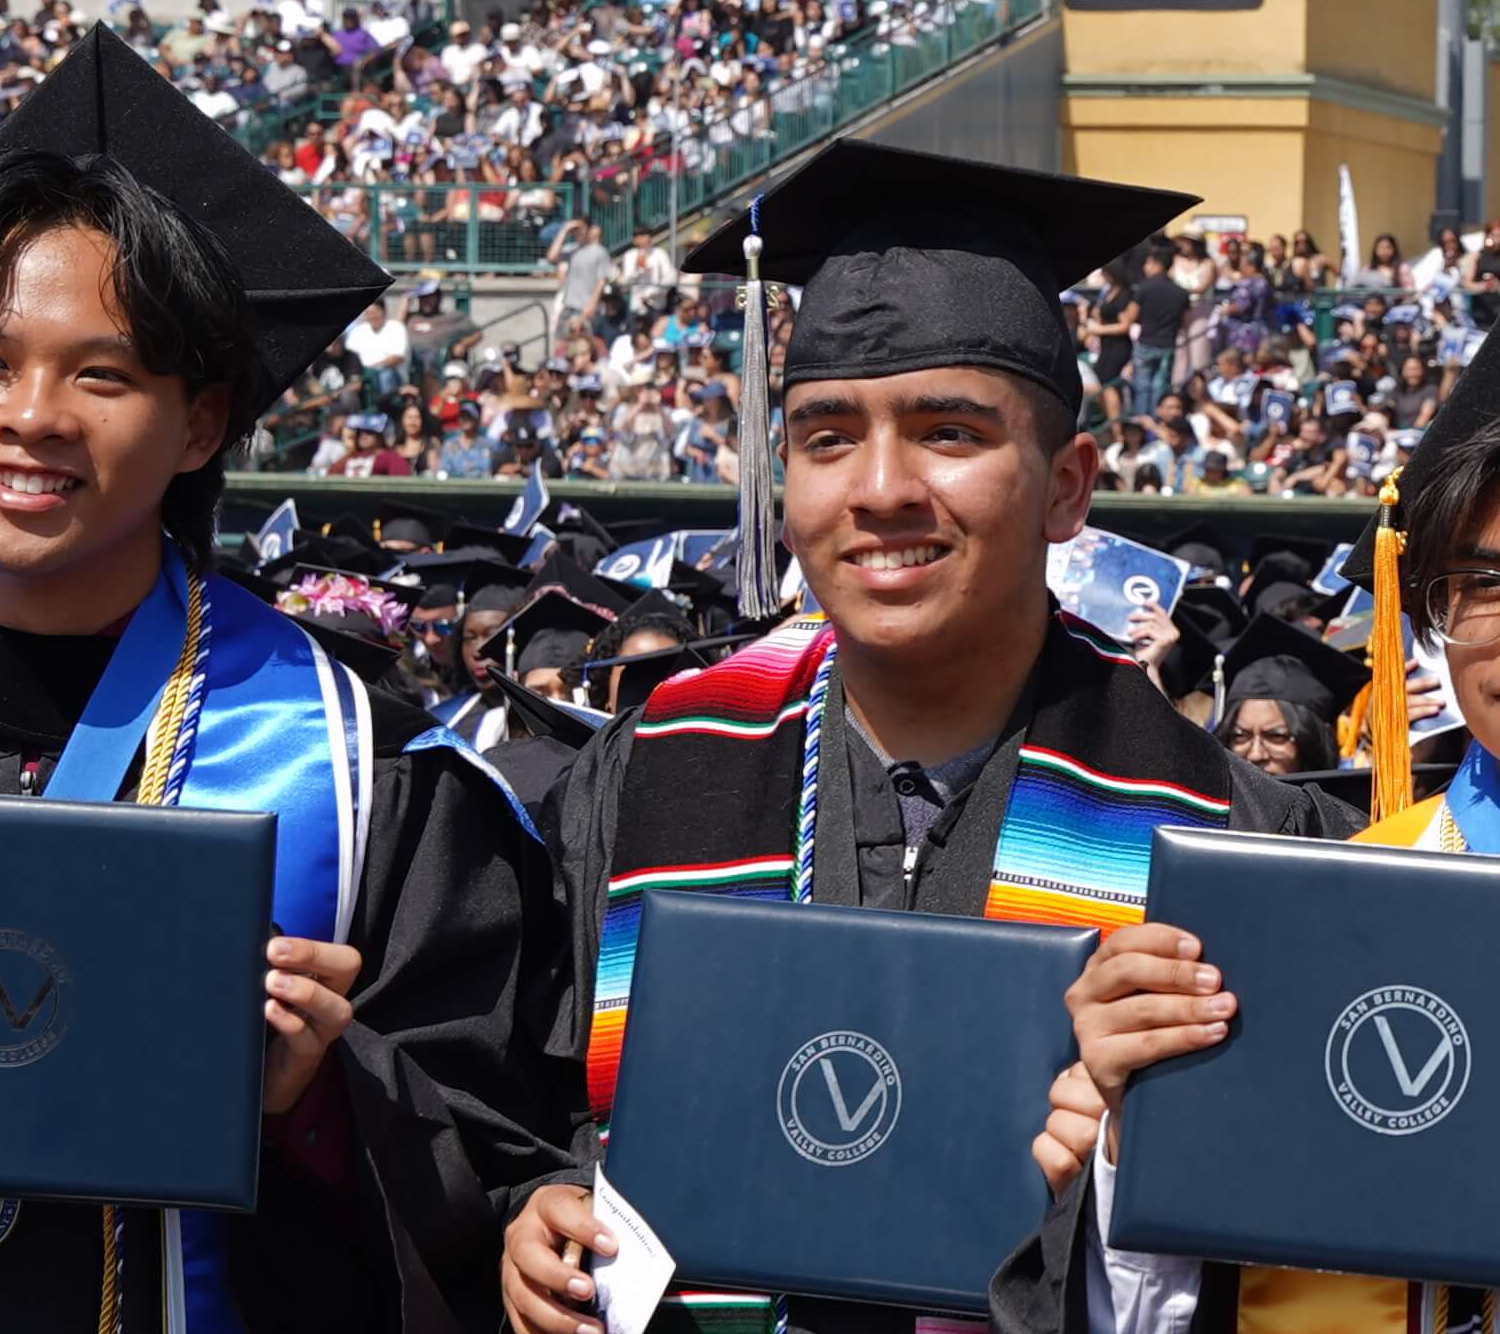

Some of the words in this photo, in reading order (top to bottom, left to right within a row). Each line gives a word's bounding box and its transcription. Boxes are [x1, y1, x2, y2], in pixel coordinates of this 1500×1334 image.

[1341, 1003, 1368, 1030] SAN
[1373, 991, 1463, 1046] BERNARDINO
[792, 1046, 816, 1071] SAN
[820, 1036, 895, 1086] BERNARDINO
[1373, 1016, 1451, 1097] V
[820, 1059, 886, 1131] V
[1338, 1082, 1382, 1124] VALLEY
[1388, 1097, 1449, 1128] COLLEGE
[787, 1119, 823, 1157] VALLEY
[828, 1132, 881, 1160] COLLEGE
